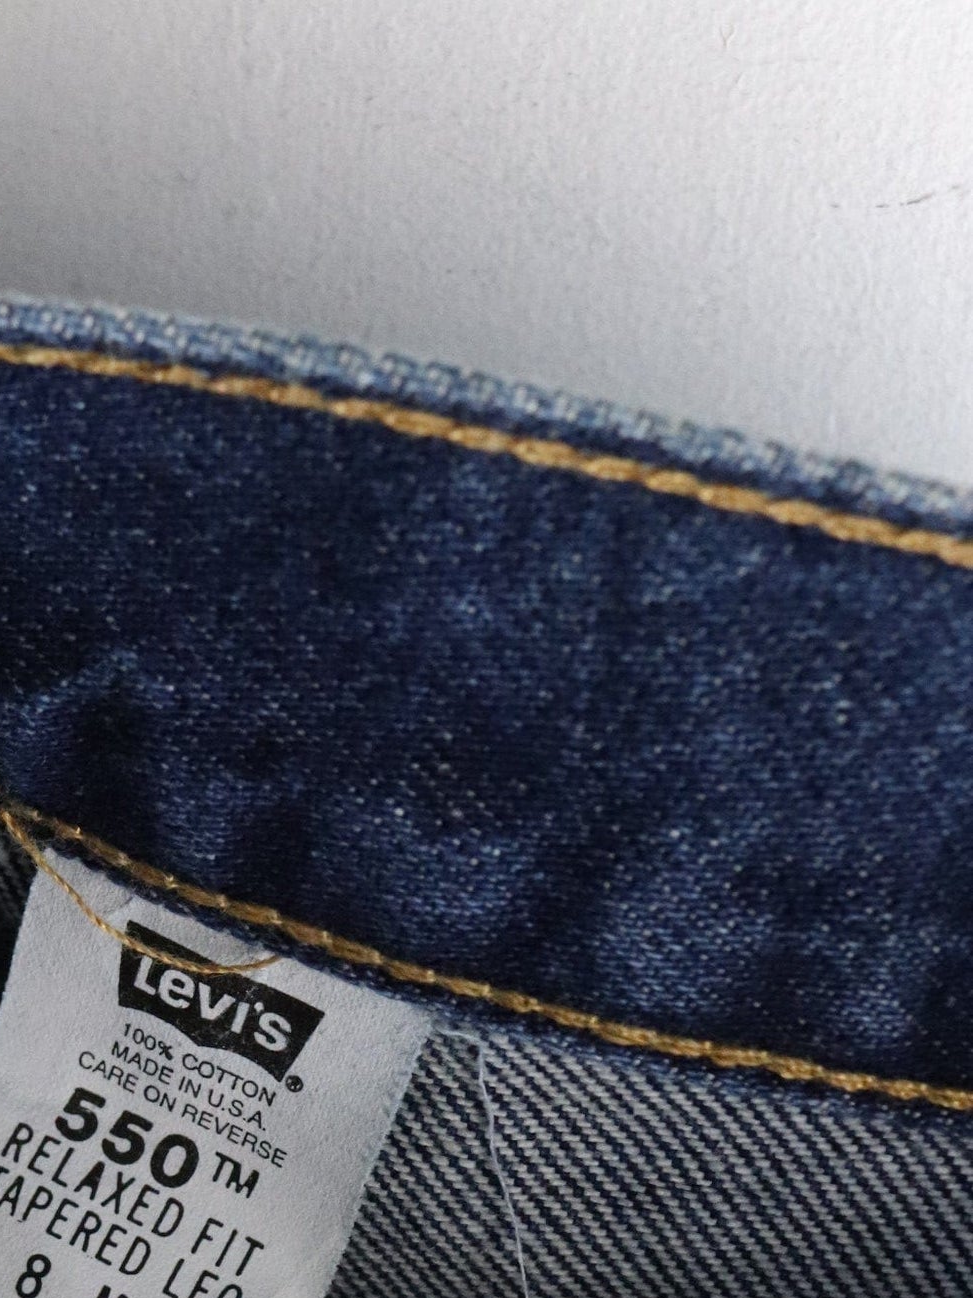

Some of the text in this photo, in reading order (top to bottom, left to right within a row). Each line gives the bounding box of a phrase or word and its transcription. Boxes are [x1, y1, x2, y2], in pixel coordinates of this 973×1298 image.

[78, 1051, 288, 1168] CARE ON REVERSE
[111, 1041, 267, 1131] MADE IN U.S.A.
[123, 1023, 277, 1107] 100% COTTON
[0, 1122, 265, 1277] RELAXED FIT
